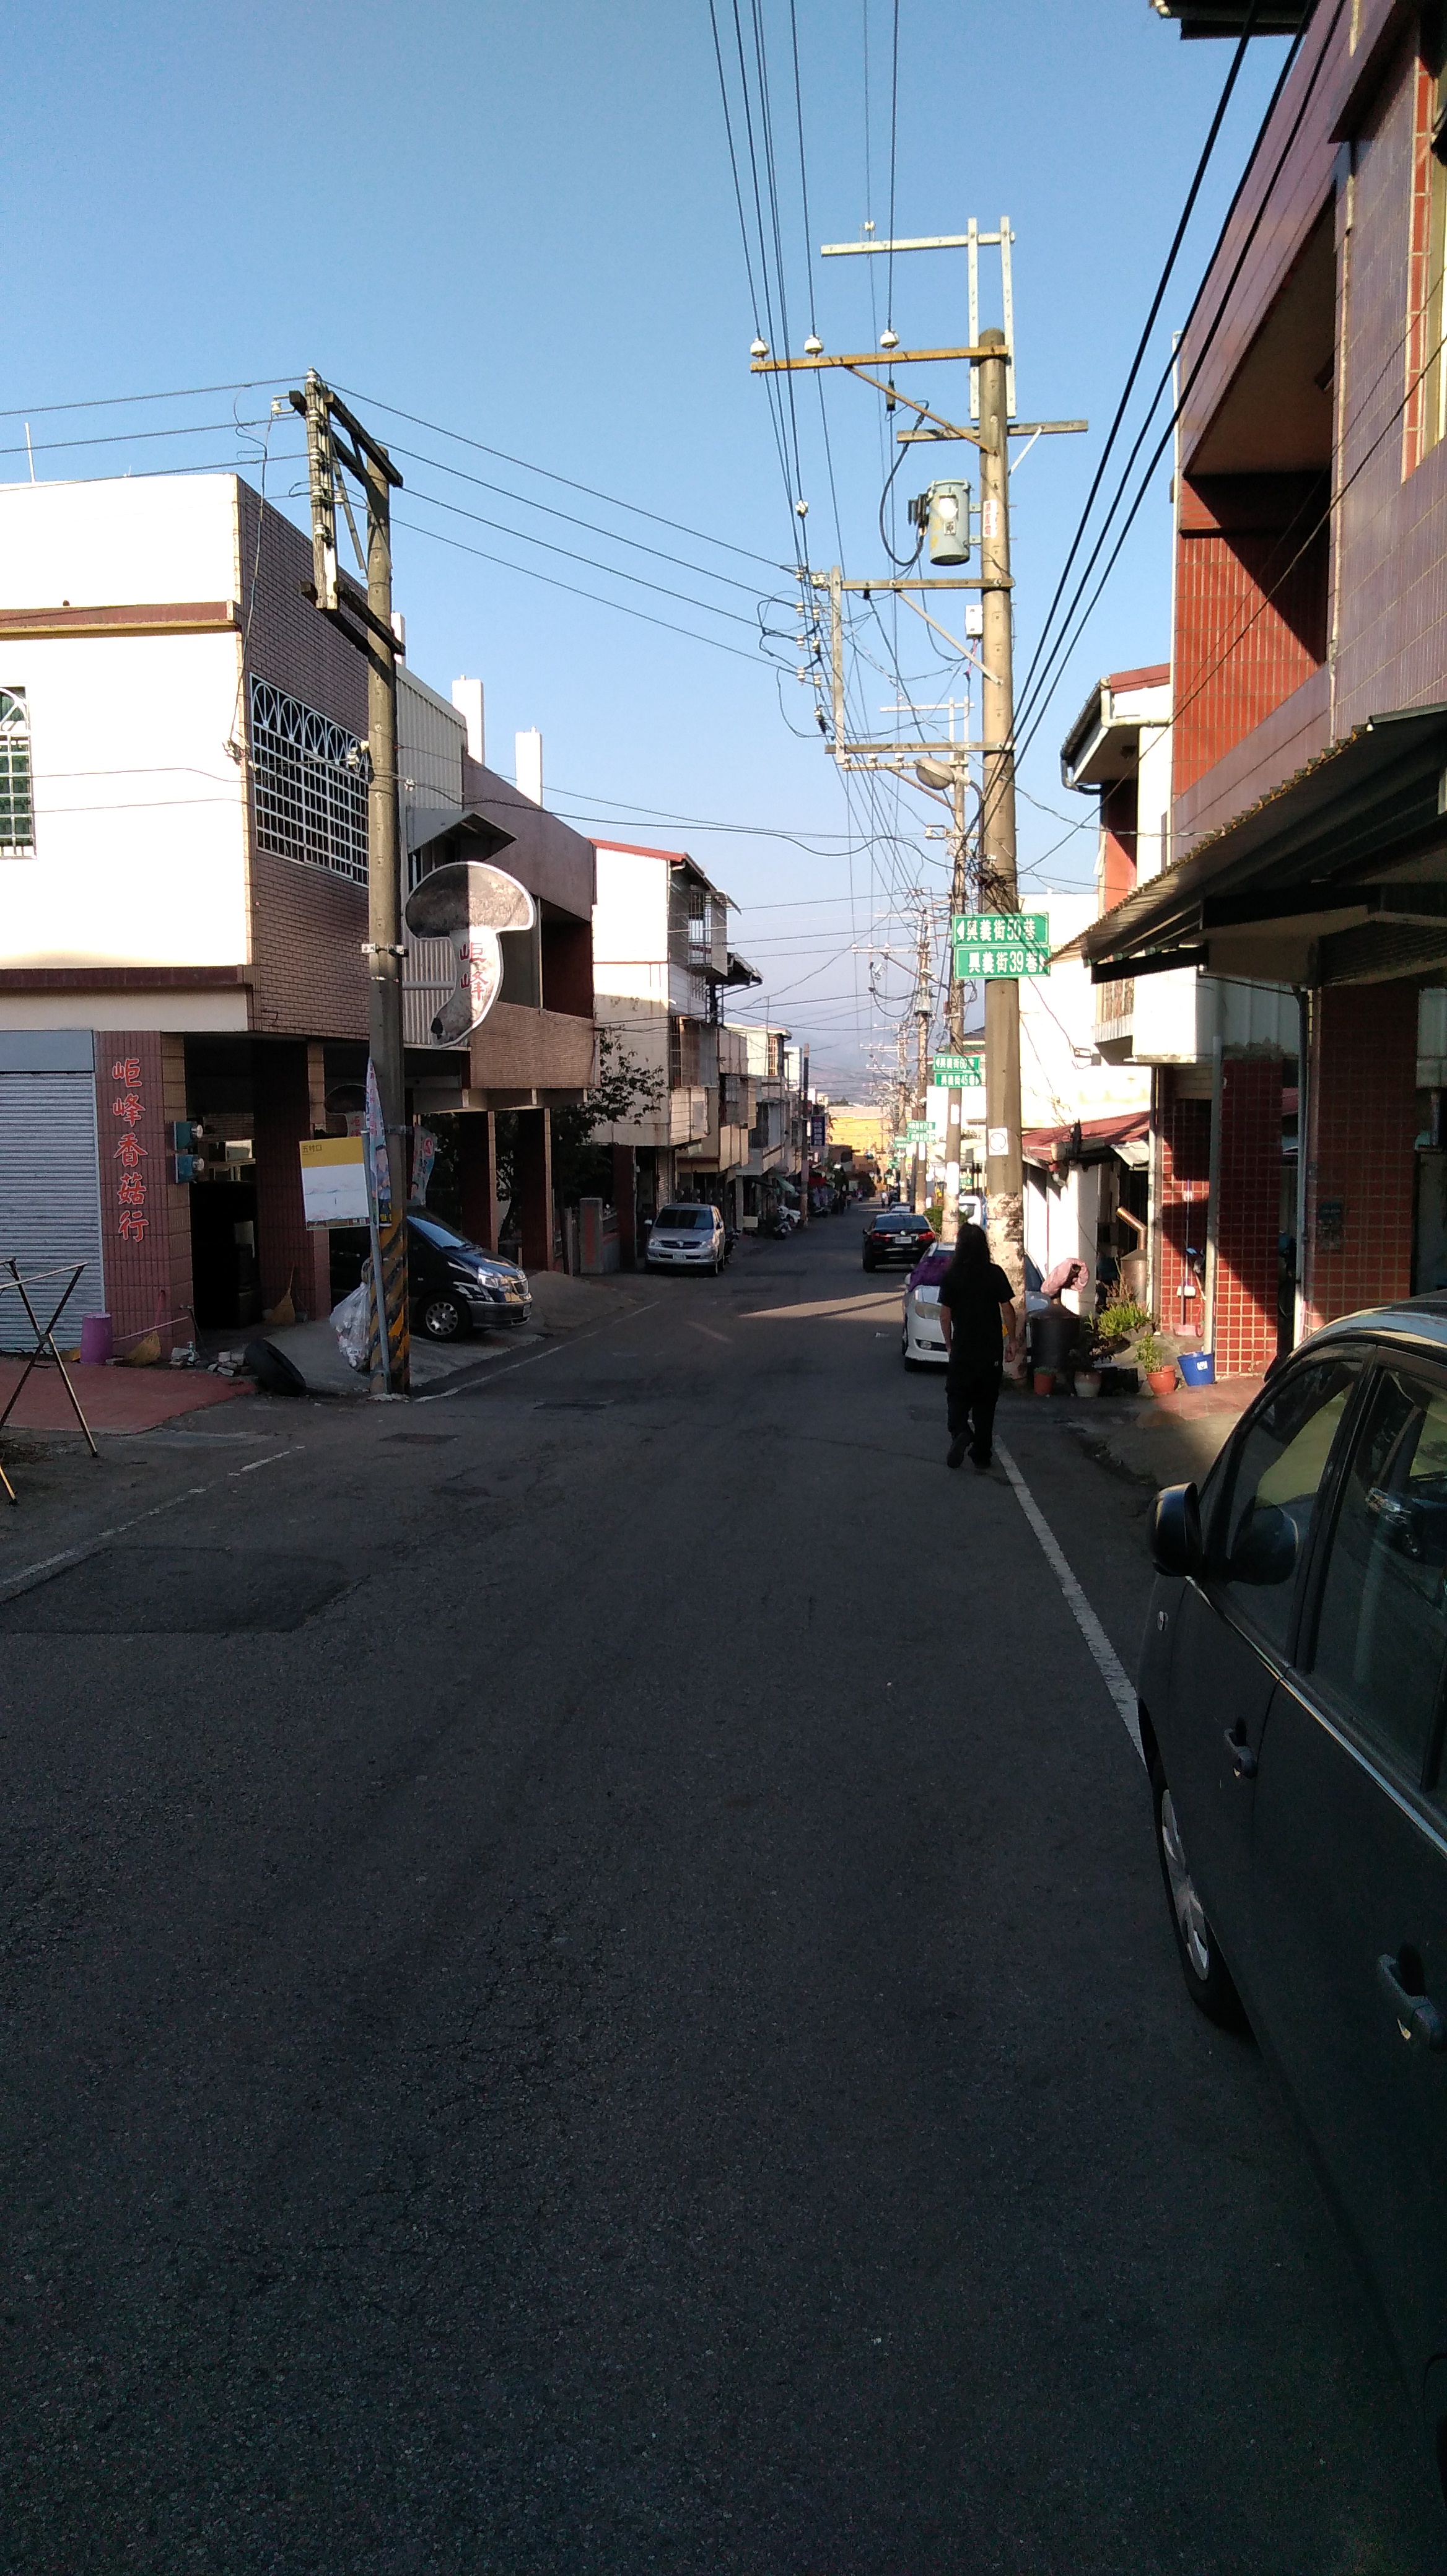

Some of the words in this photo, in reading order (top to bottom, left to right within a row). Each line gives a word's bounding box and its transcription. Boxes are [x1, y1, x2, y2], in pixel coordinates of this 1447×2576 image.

[966, 918, 1036, 942] 興義街50巷
[968, 951, 1038, 973] 興義街39巷
[112, 1058, 149, 1242] 岠峰香菇行
